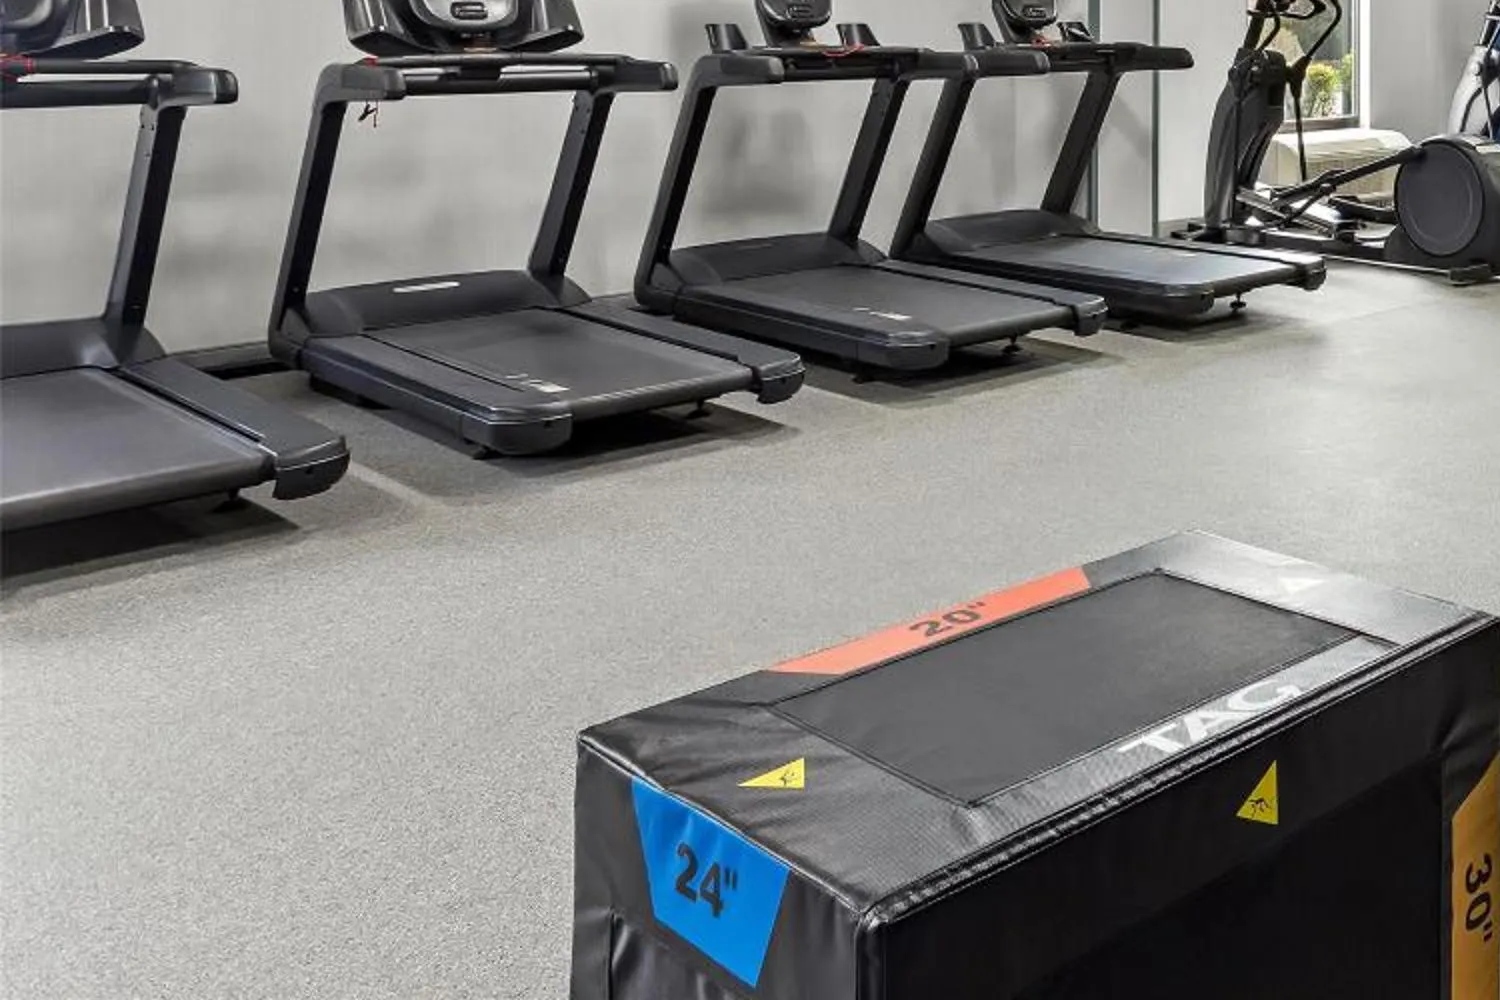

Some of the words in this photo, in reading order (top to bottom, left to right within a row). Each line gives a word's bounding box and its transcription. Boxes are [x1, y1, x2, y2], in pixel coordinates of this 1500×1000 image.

[909, 601, 986, 637] 20"
[676, 842, 738, 918] 24"
[1465, 853, 1493, 942] 30"
